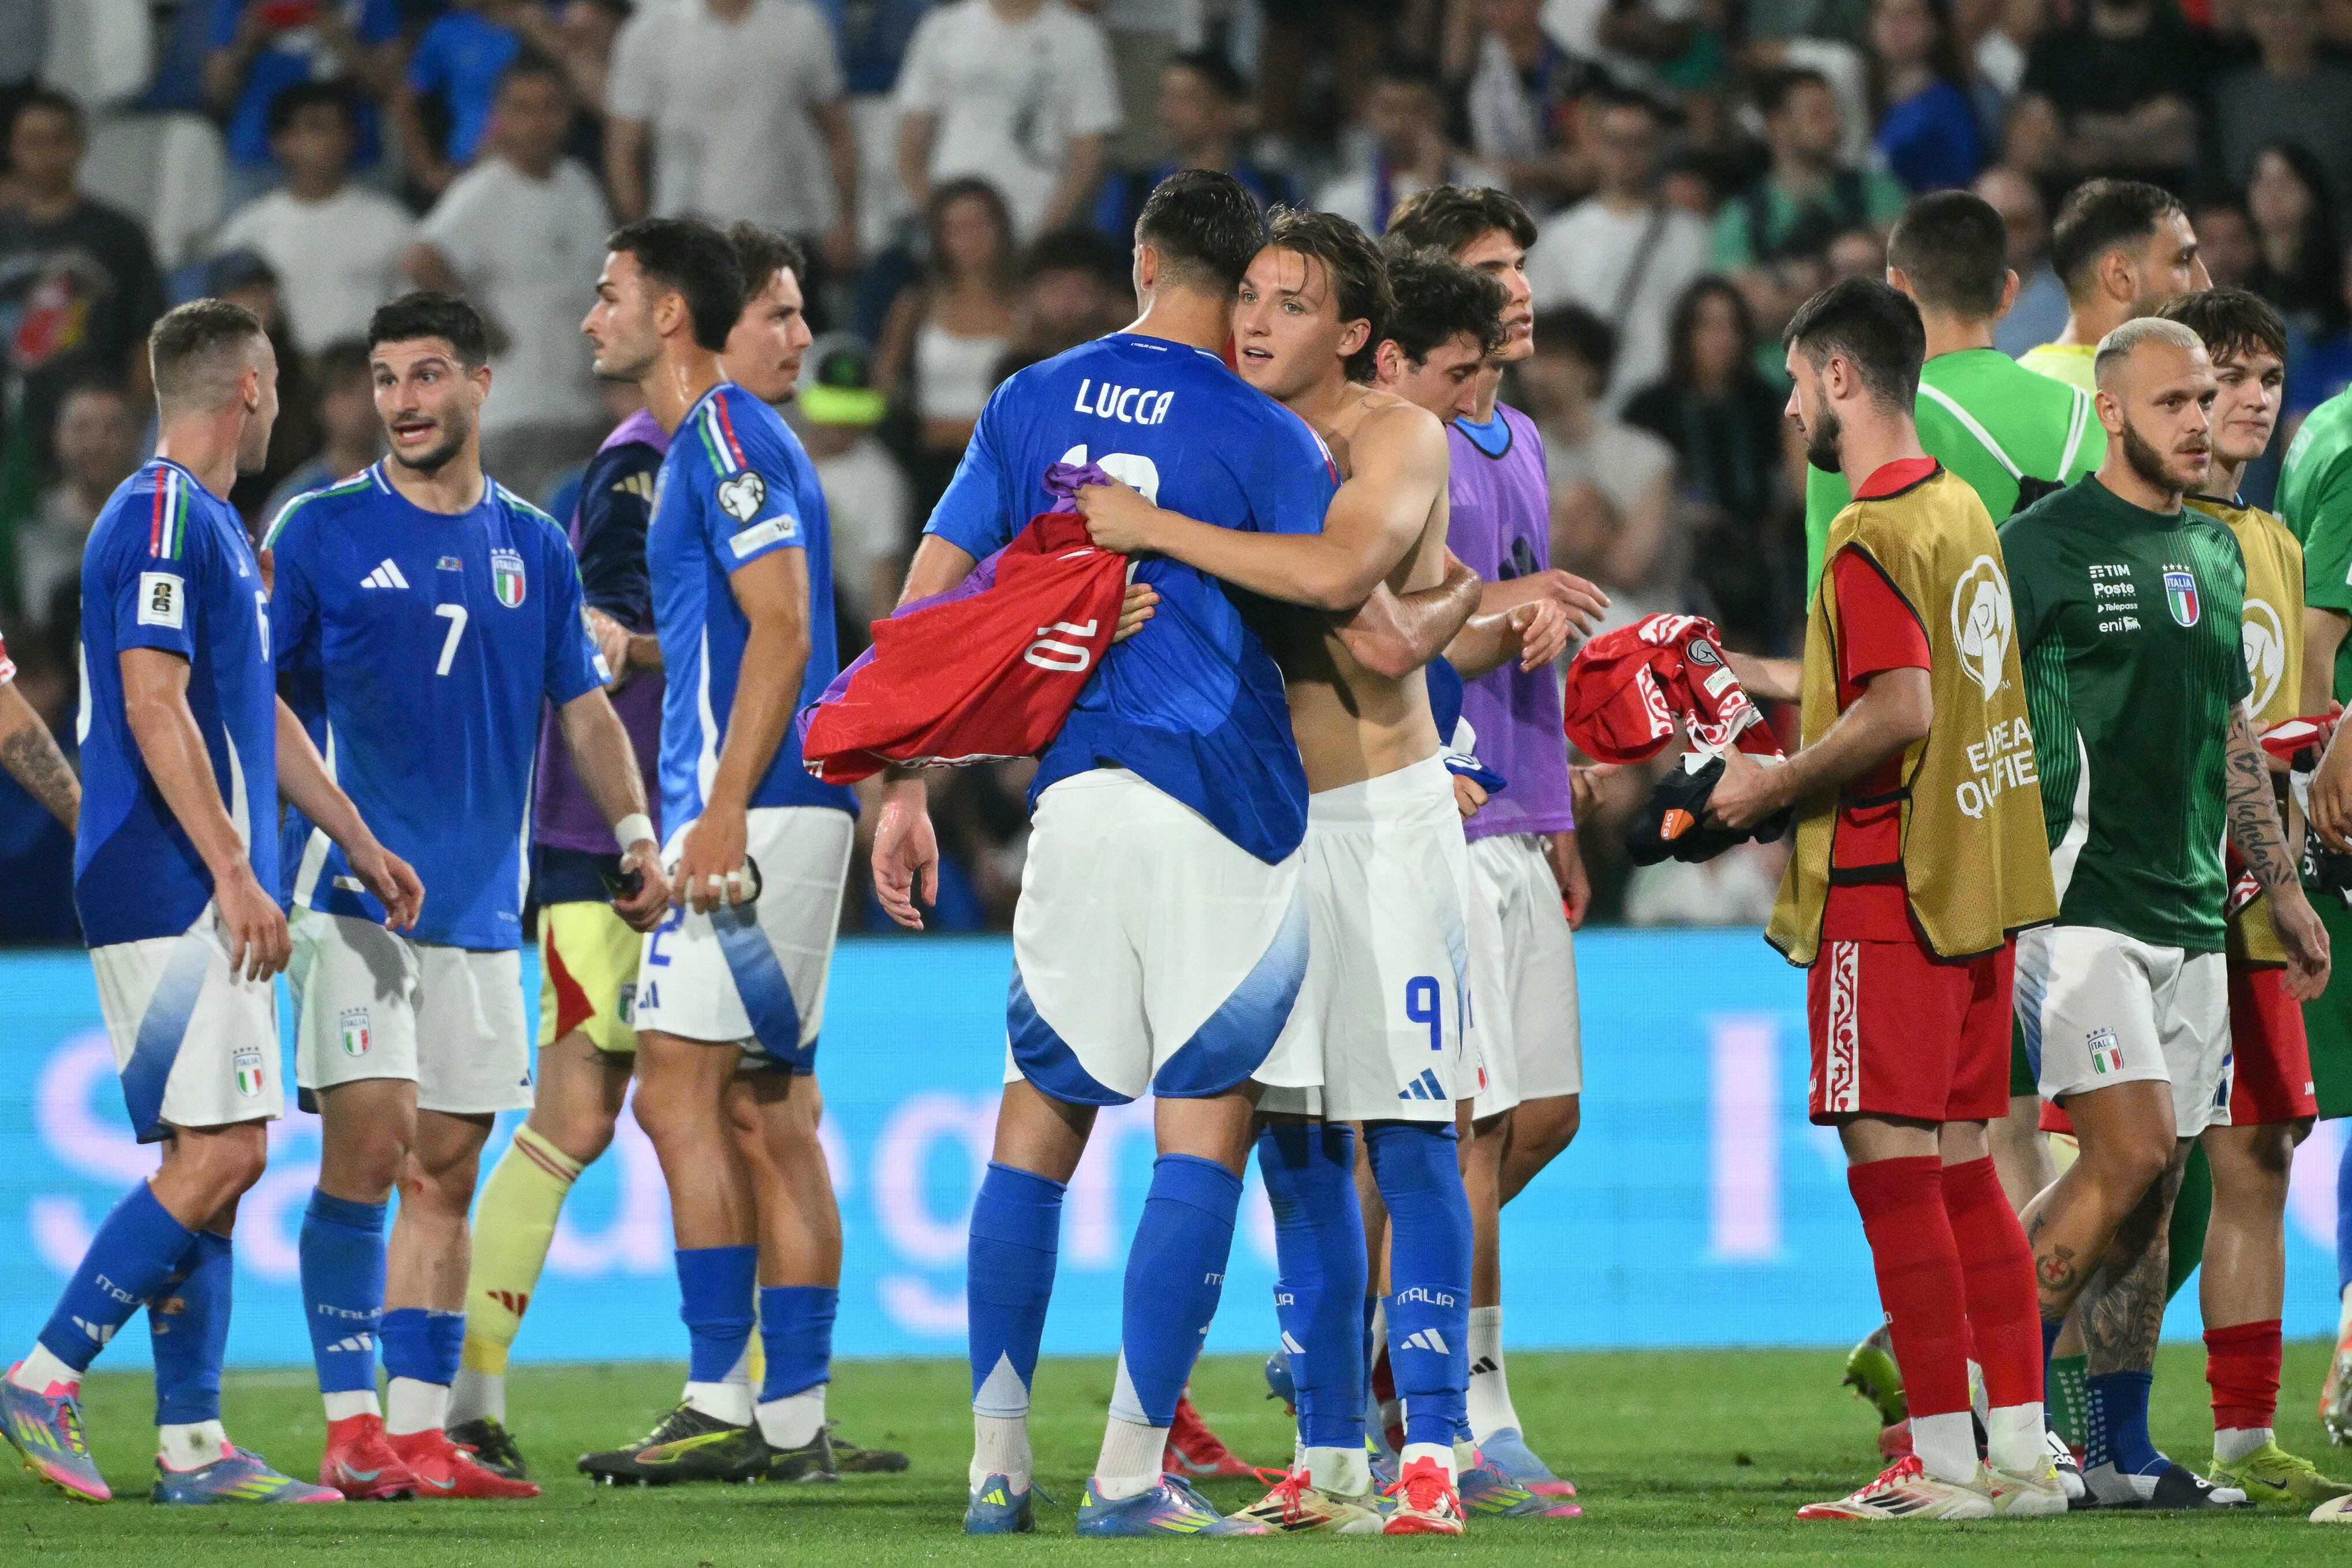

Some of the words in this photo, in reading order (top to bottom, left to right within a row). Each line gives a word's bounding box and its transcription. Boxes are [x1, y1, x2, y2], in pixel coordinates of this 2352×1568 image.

[1074, 379, 1175, 425] LUCCA
[2104, 564, 2131, 577] TIM
[2093, 582, 2135, 596] Poste
[2167, 577, 2192, 588] ITALIA
[2104, 602, 2138, 612] Telepass
[2099, 618, 2123, 632] eni
[435, 603, 468, 676] 7
[1024, 619, 1097, 672] 10
[1405, 975, 1442, 1051] 9
[1397, 1287, 1455, 1308] ITALIA
